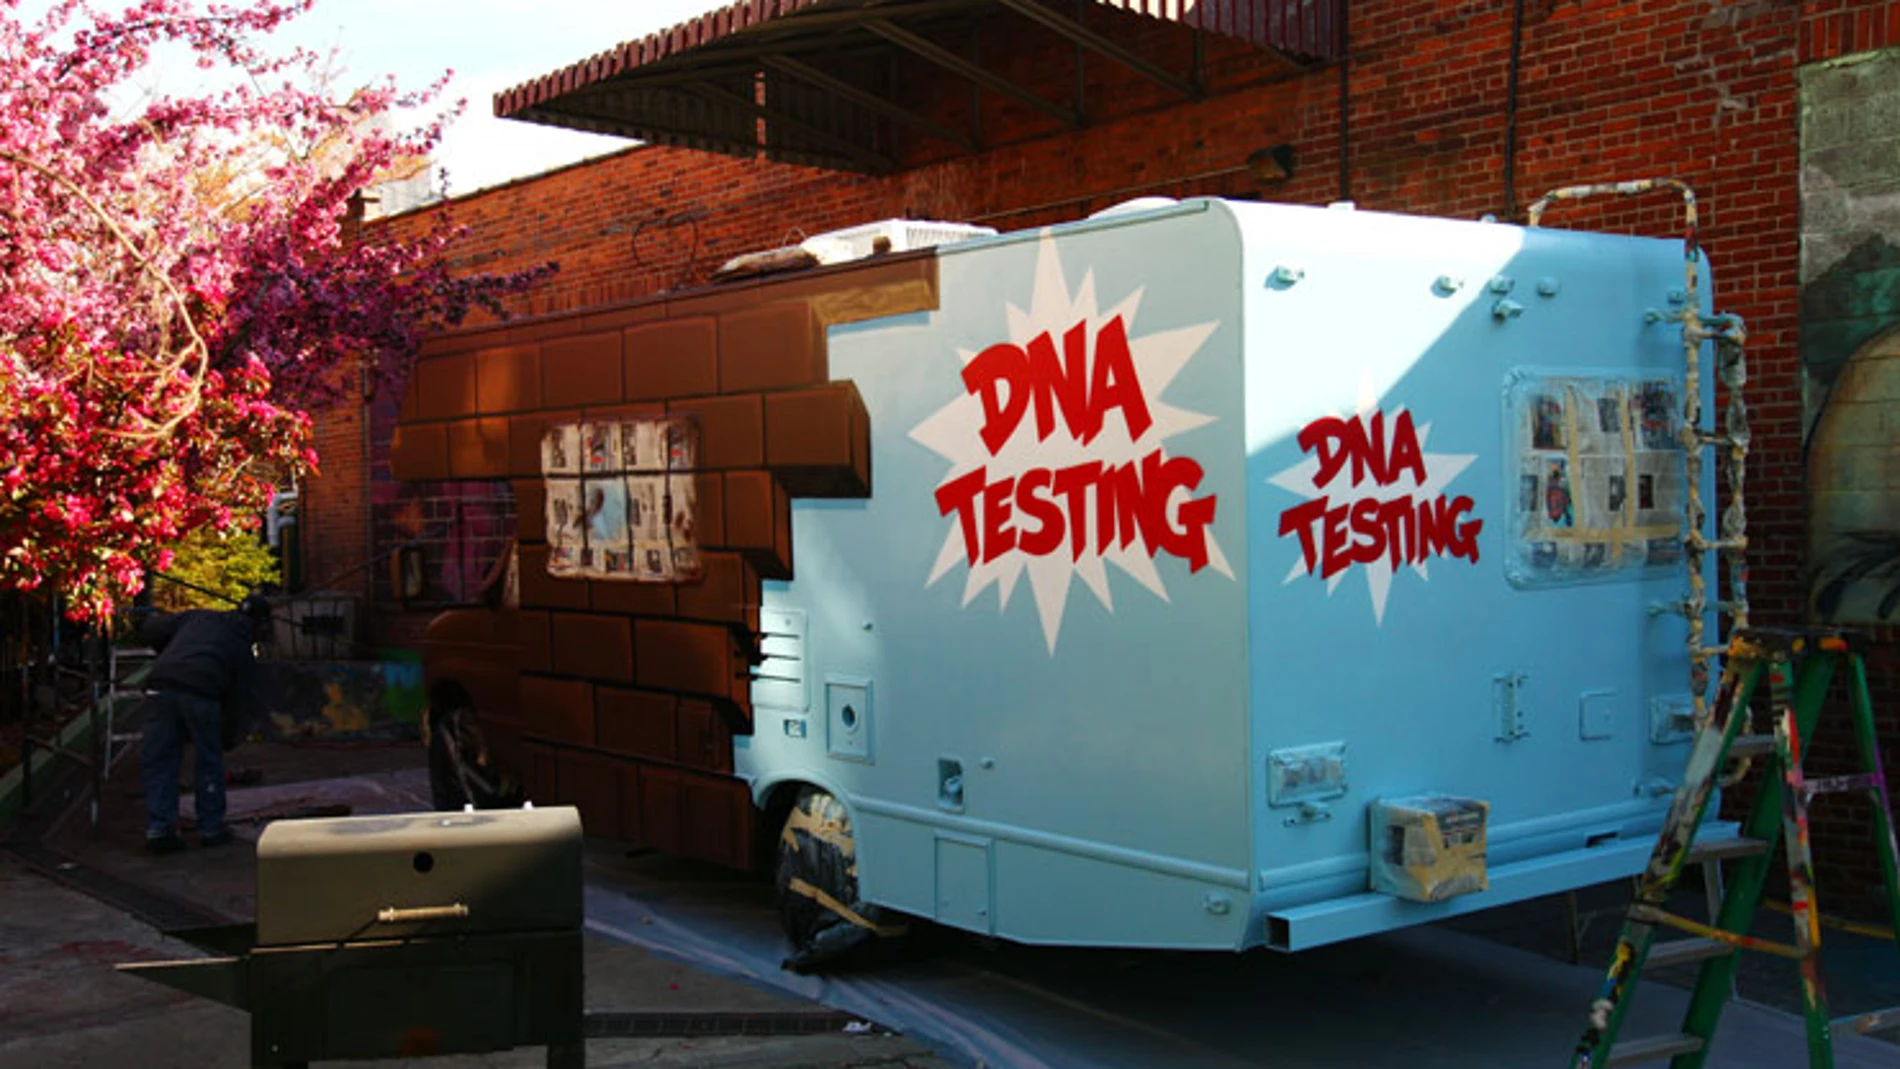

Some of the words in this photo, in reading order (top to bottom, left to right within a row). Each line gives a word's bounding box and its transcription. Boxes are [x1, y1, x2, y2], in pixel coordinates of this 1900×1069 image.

[960, 313, 1154, 458] DNA
[1297, 409, 1428, 489] DNA
[934, 447, 1218, 575] TESTING
[1278, 493, 1484, 580] TESTING
